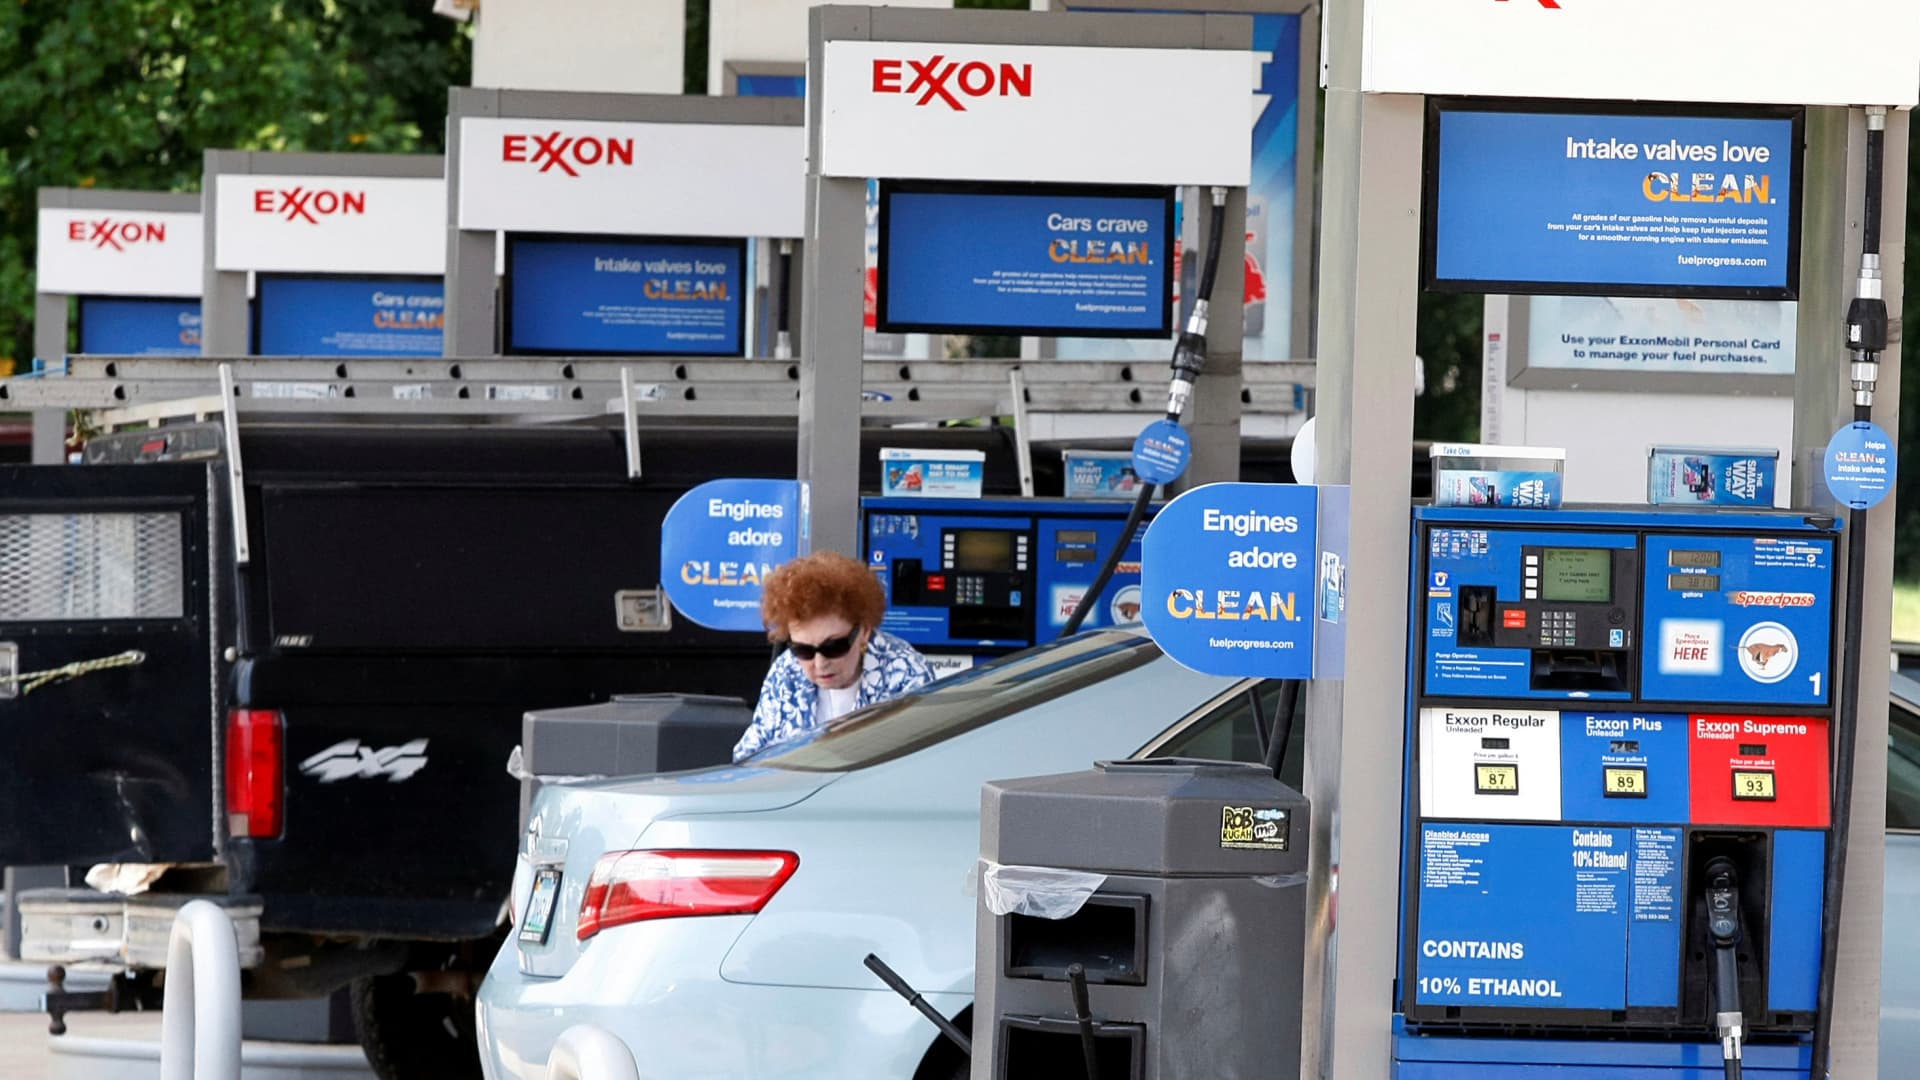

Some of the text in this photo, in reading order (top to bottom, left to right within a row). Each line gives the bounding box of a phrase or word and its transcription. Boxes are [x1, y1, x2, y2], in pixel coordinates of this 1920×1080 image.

[872, 55, 1032, 111] EXXON
[502, 132, 634, 177] EXXON
[1566, 136, 1769, 163] Intake valves love
[1642, 172, 1776, 204] CLEAN.
[255, 186, 364, 223] EXXON
[1048, 213, 1148, 233] Cars crave
[1572, 213, 1581, 221] All
[1610, 214, 1617, 222] of
[1618, 214, 1631, 222] our
[1664, 215, 1679, 223] help
[69, 219, 165, 251] EXXON
[1566, 223, 1581, 231] your
[1650, 225, 1663, 233] and
[1687, 235, 1701, 243] with
[1049, 239, 1153, 265] CLEAN.
[595, 257, 726, 274] Intake valves love
[1678, 255, 1767, 268] fuelprogress.com
[1562, 334, 1780, 349] Use your ExxonMobil Personal Card
[1574, 349, 1767, 363] to manage your fuel purchases.
[1443, 446, 1456, 454] Take
[1865, 441, 1886, 450] Helps
[1836, 451, 1875, 462] CLEAN
[1074, 475, 1102, 484] WAY
[1726, 467, 1731, 476] TO
[1732, 461, 1746, 499] WAY
[1747, 460, 1756, 499] SMART
[1520, 480, 1534, 506] WA
[709, 499, 783, 521] Engines
[1204, 509, 1298, 536] Engines
[728, 527, 783, 546] adore
[1228, 546, 1297, 568] adore
[1168, 589, 1301, 622] CLEAN.
[1737, 592, 1814, 607] Speedpass
[1209, 638, 1294, 649] fuelprogress.com
[1674, 648, 1709, 660] HERE
[1809, 672, 1821, 696] 1
[1446, 713, 1545, 729] Exxon Regular
[1586, 717, 1662, 730] Exxon Plus
[1697, 719, 1806, 736] Exxon Supreme
[1586, 729, 1624, 737] Unleaded
[1697, 731, 1734, 739] Unleaded
[1489, 773, 1505, 785] 87
[1617, 776, 1634, 788] 89
[1746, 780, 1763, 792] 93
[1223, 806, 1252, 829] ROB
[1222, 829, 1252, 840] RUGAH
[1425, 830, 1489, 840] Disabled Access
[1573, 829, 1613, 847] Contains
[1572, 850, 1627, 870] 10% Ethanol
[1423, 940, 1524, 959] CONTAINS
[1419, 977, 1562, 997] 10% ETHANOL
